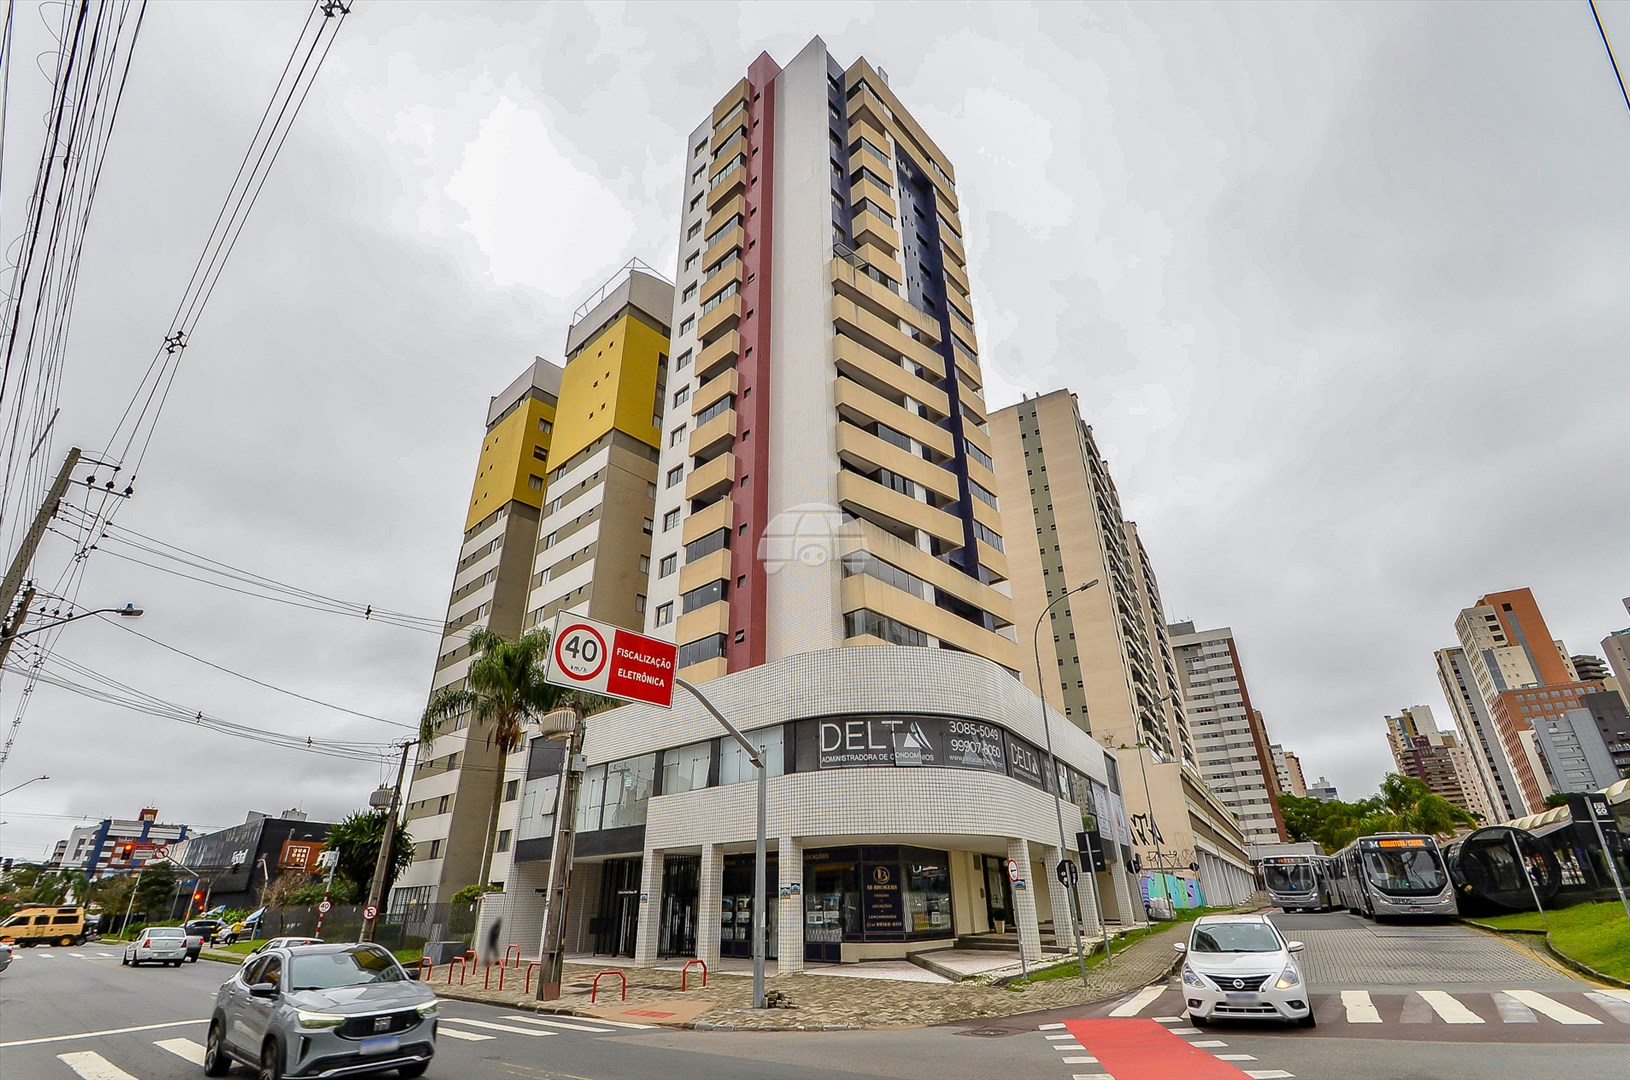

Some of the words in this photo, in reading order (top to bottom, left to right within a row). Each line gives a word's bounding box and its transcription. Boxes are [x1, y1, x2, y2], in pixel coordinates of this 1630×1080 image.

[564, 635, 598, 663] 40
[616, 647, 671, 670] FISCALIZAÇÃO
[617, 668, 665, 688] ELETRÔNICA
[949, 721, 999, 741] 3085-5049
[821, 754, 877, 763] ADMINISTRADORA
